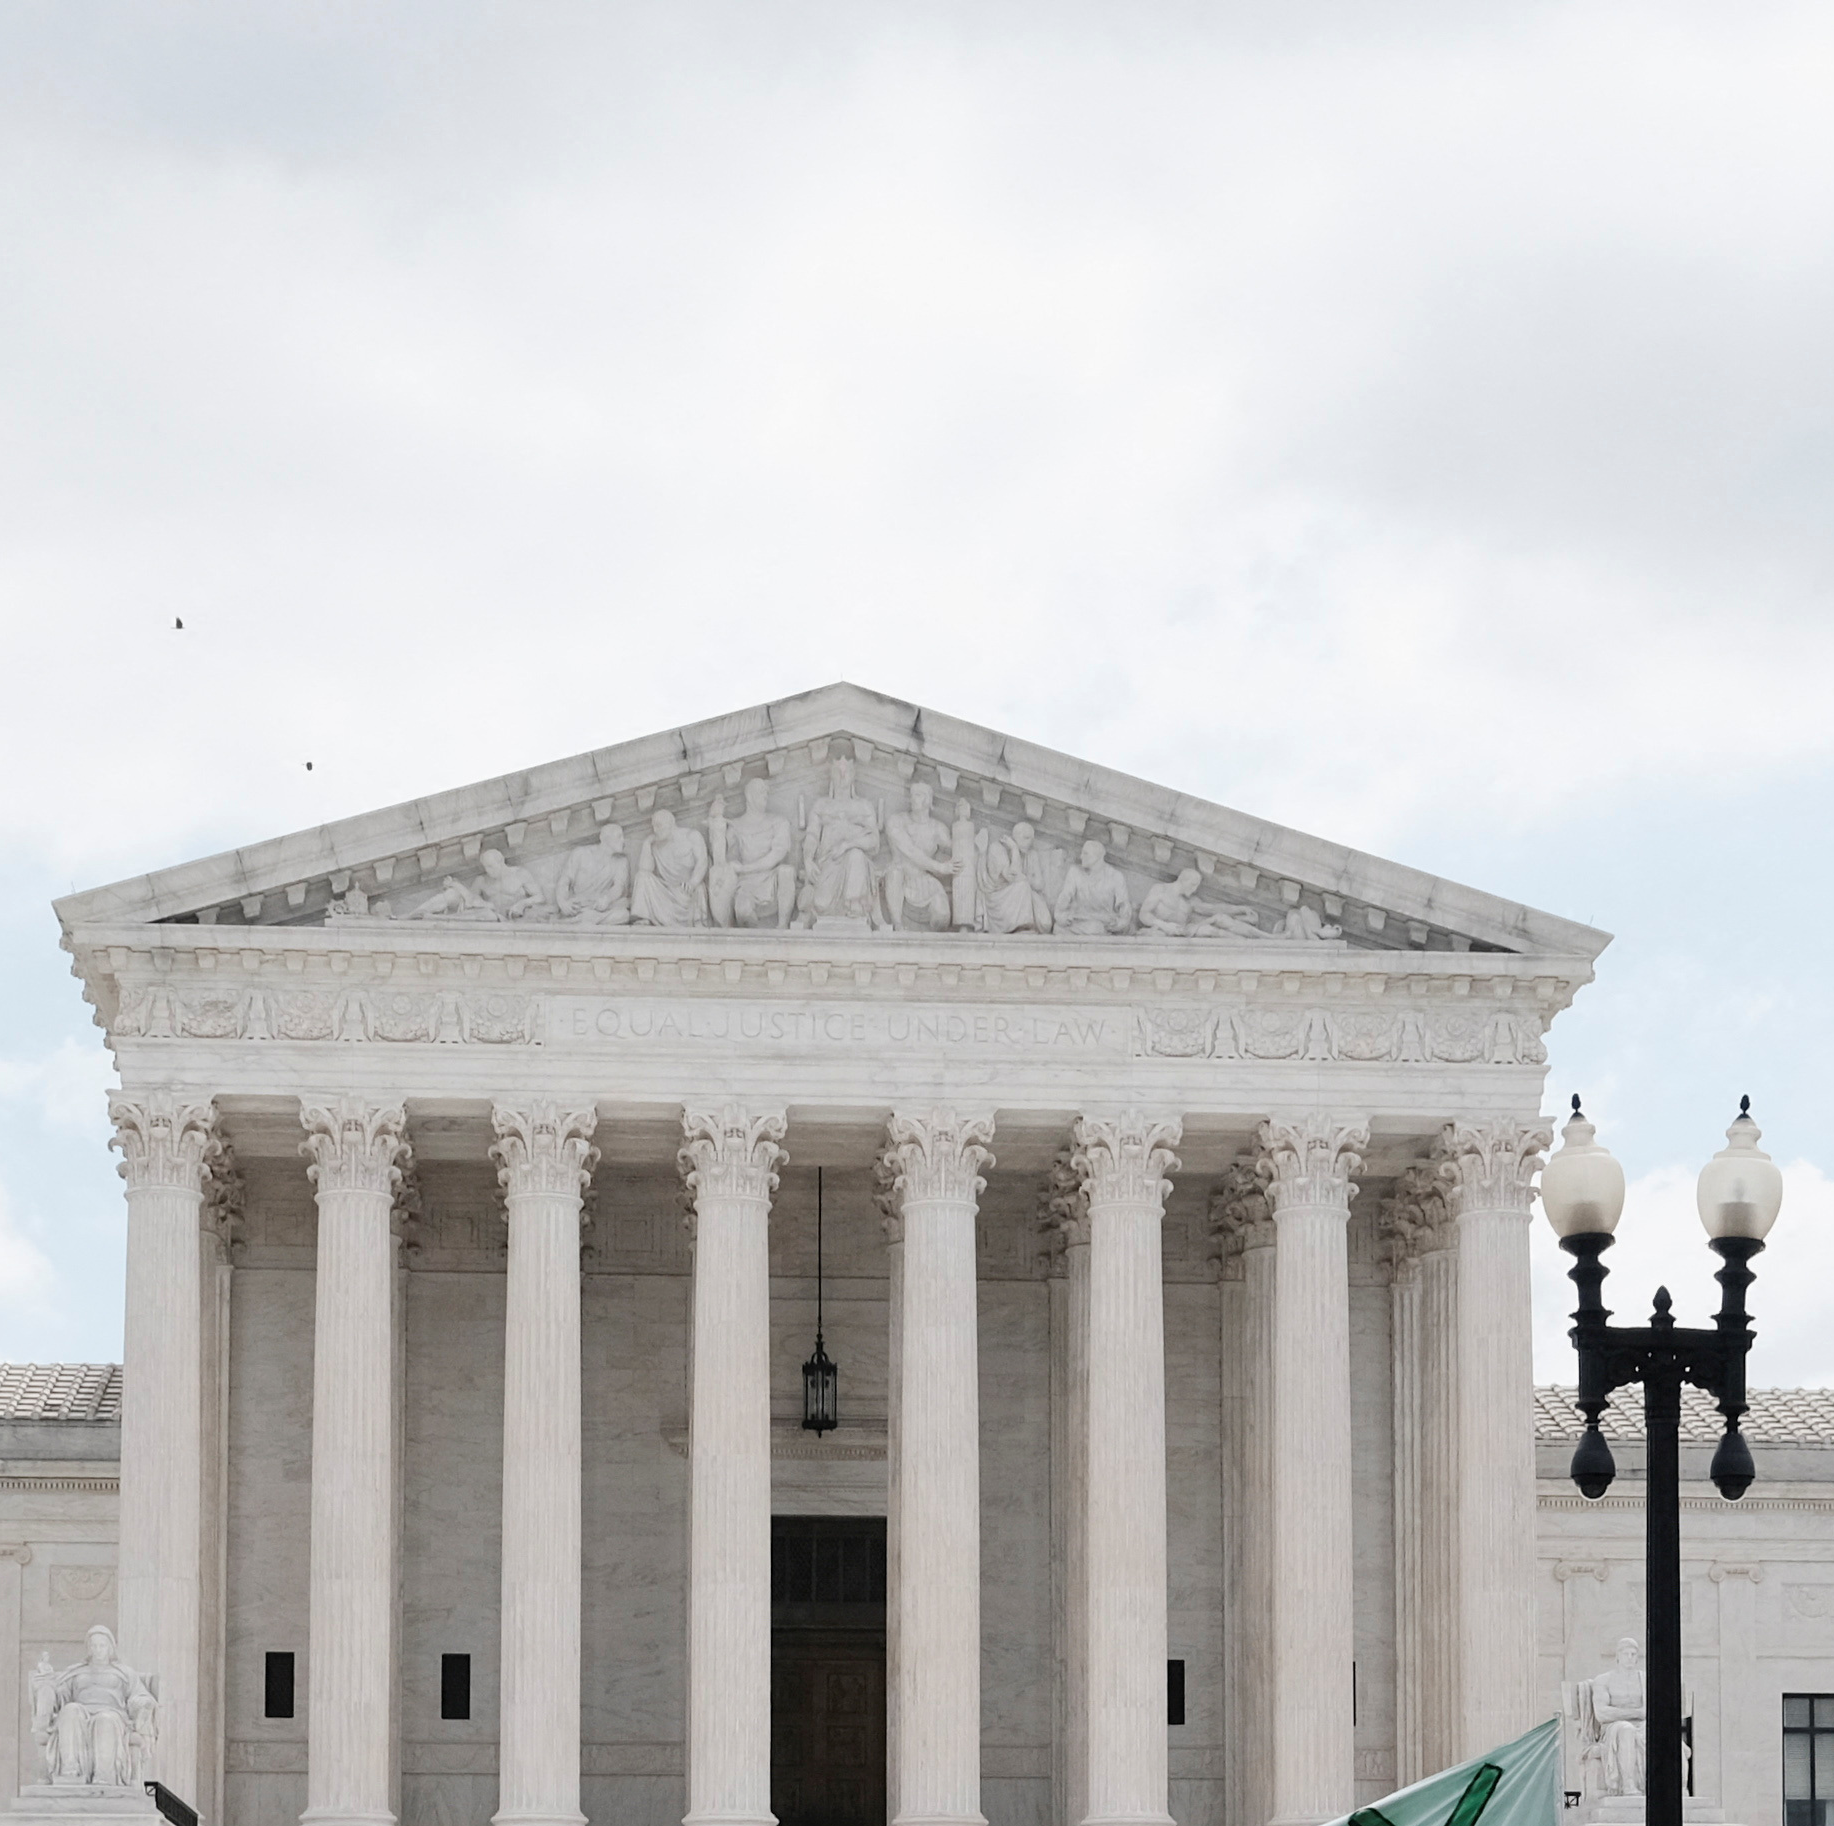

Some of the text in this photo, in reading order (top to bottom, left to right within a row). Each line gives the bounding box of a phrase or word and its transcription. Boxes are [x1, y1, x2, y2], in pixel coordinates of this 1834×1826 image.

[571, 1007, 1107, 1046] EQUAL JUSTICE UNDER LAW
